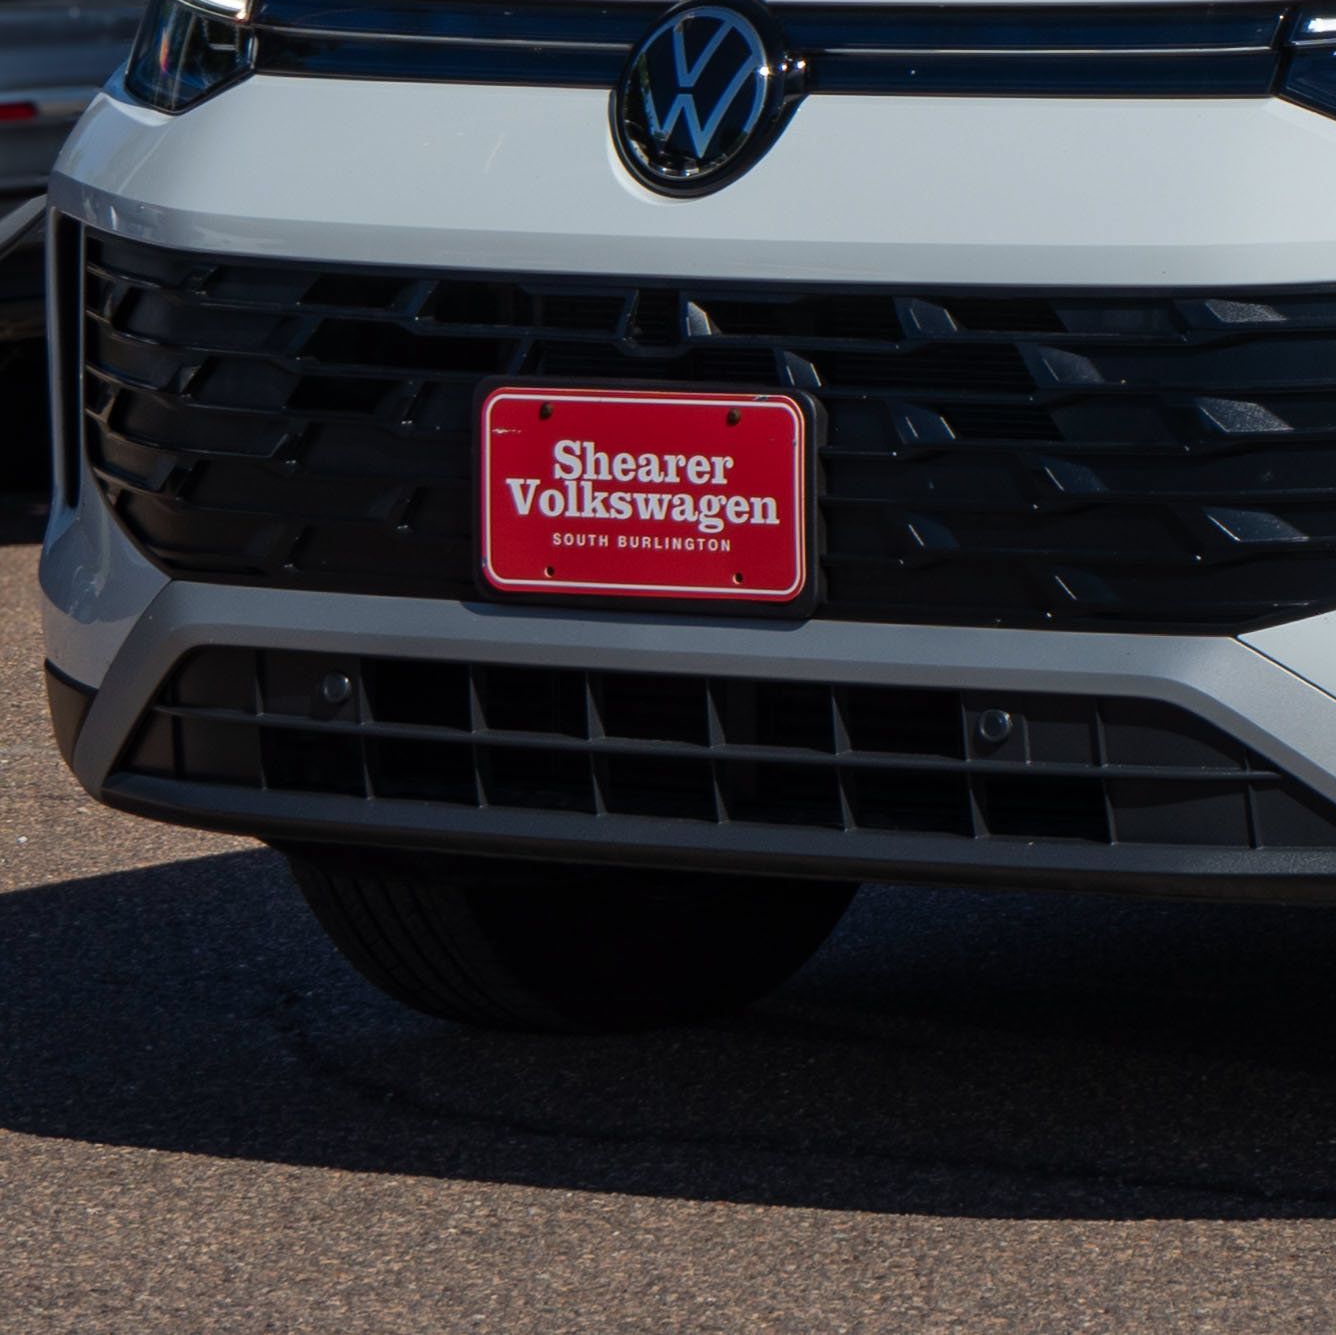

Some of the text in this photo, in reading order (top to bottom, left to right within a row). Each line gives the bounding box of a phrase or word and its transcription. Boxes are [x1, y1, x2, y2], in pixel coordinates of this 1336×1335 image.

[553, 439, 734, 485] Shearer
[506, 478, 780, 534] Volkswagen
[552, 532, 732, 552] SOUTH BURLINGTON
